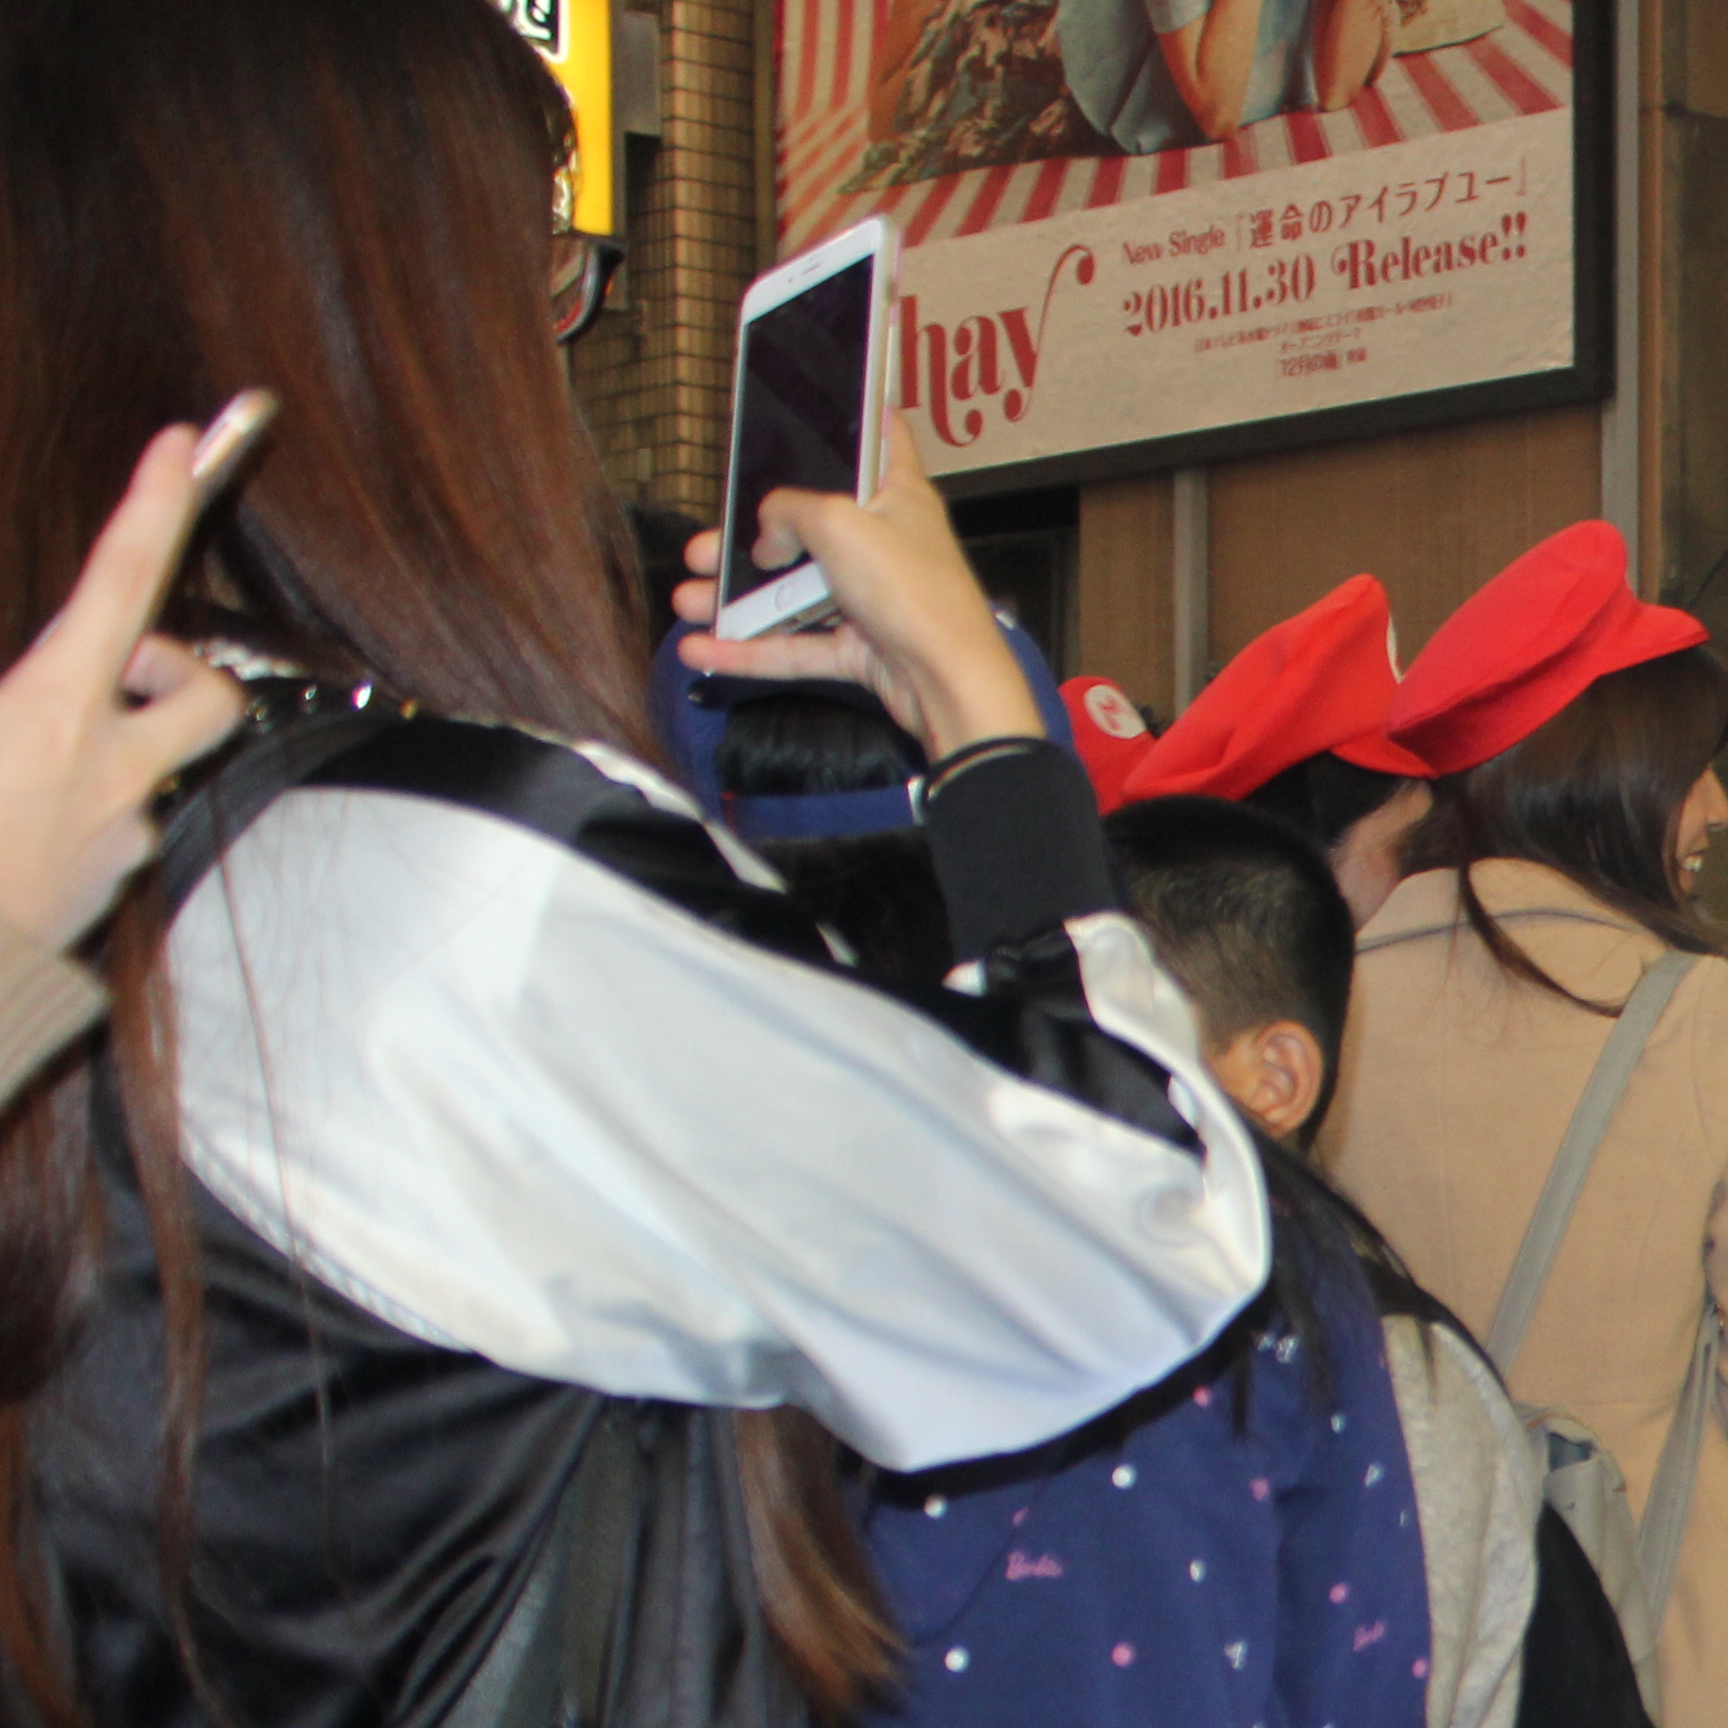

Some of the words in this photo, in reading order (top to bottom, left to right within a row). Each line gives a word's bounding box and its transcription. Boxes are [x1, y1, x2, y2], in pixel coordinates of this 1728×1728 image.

[1122, 254, 1316, 338] 2016.11.30
[1330, 211, 1528, 291] Release!!
[1123, 240, 1161, 267] New
[1168, 225, 1226, 257] Single
[900, 243, 1095, 447] hay
